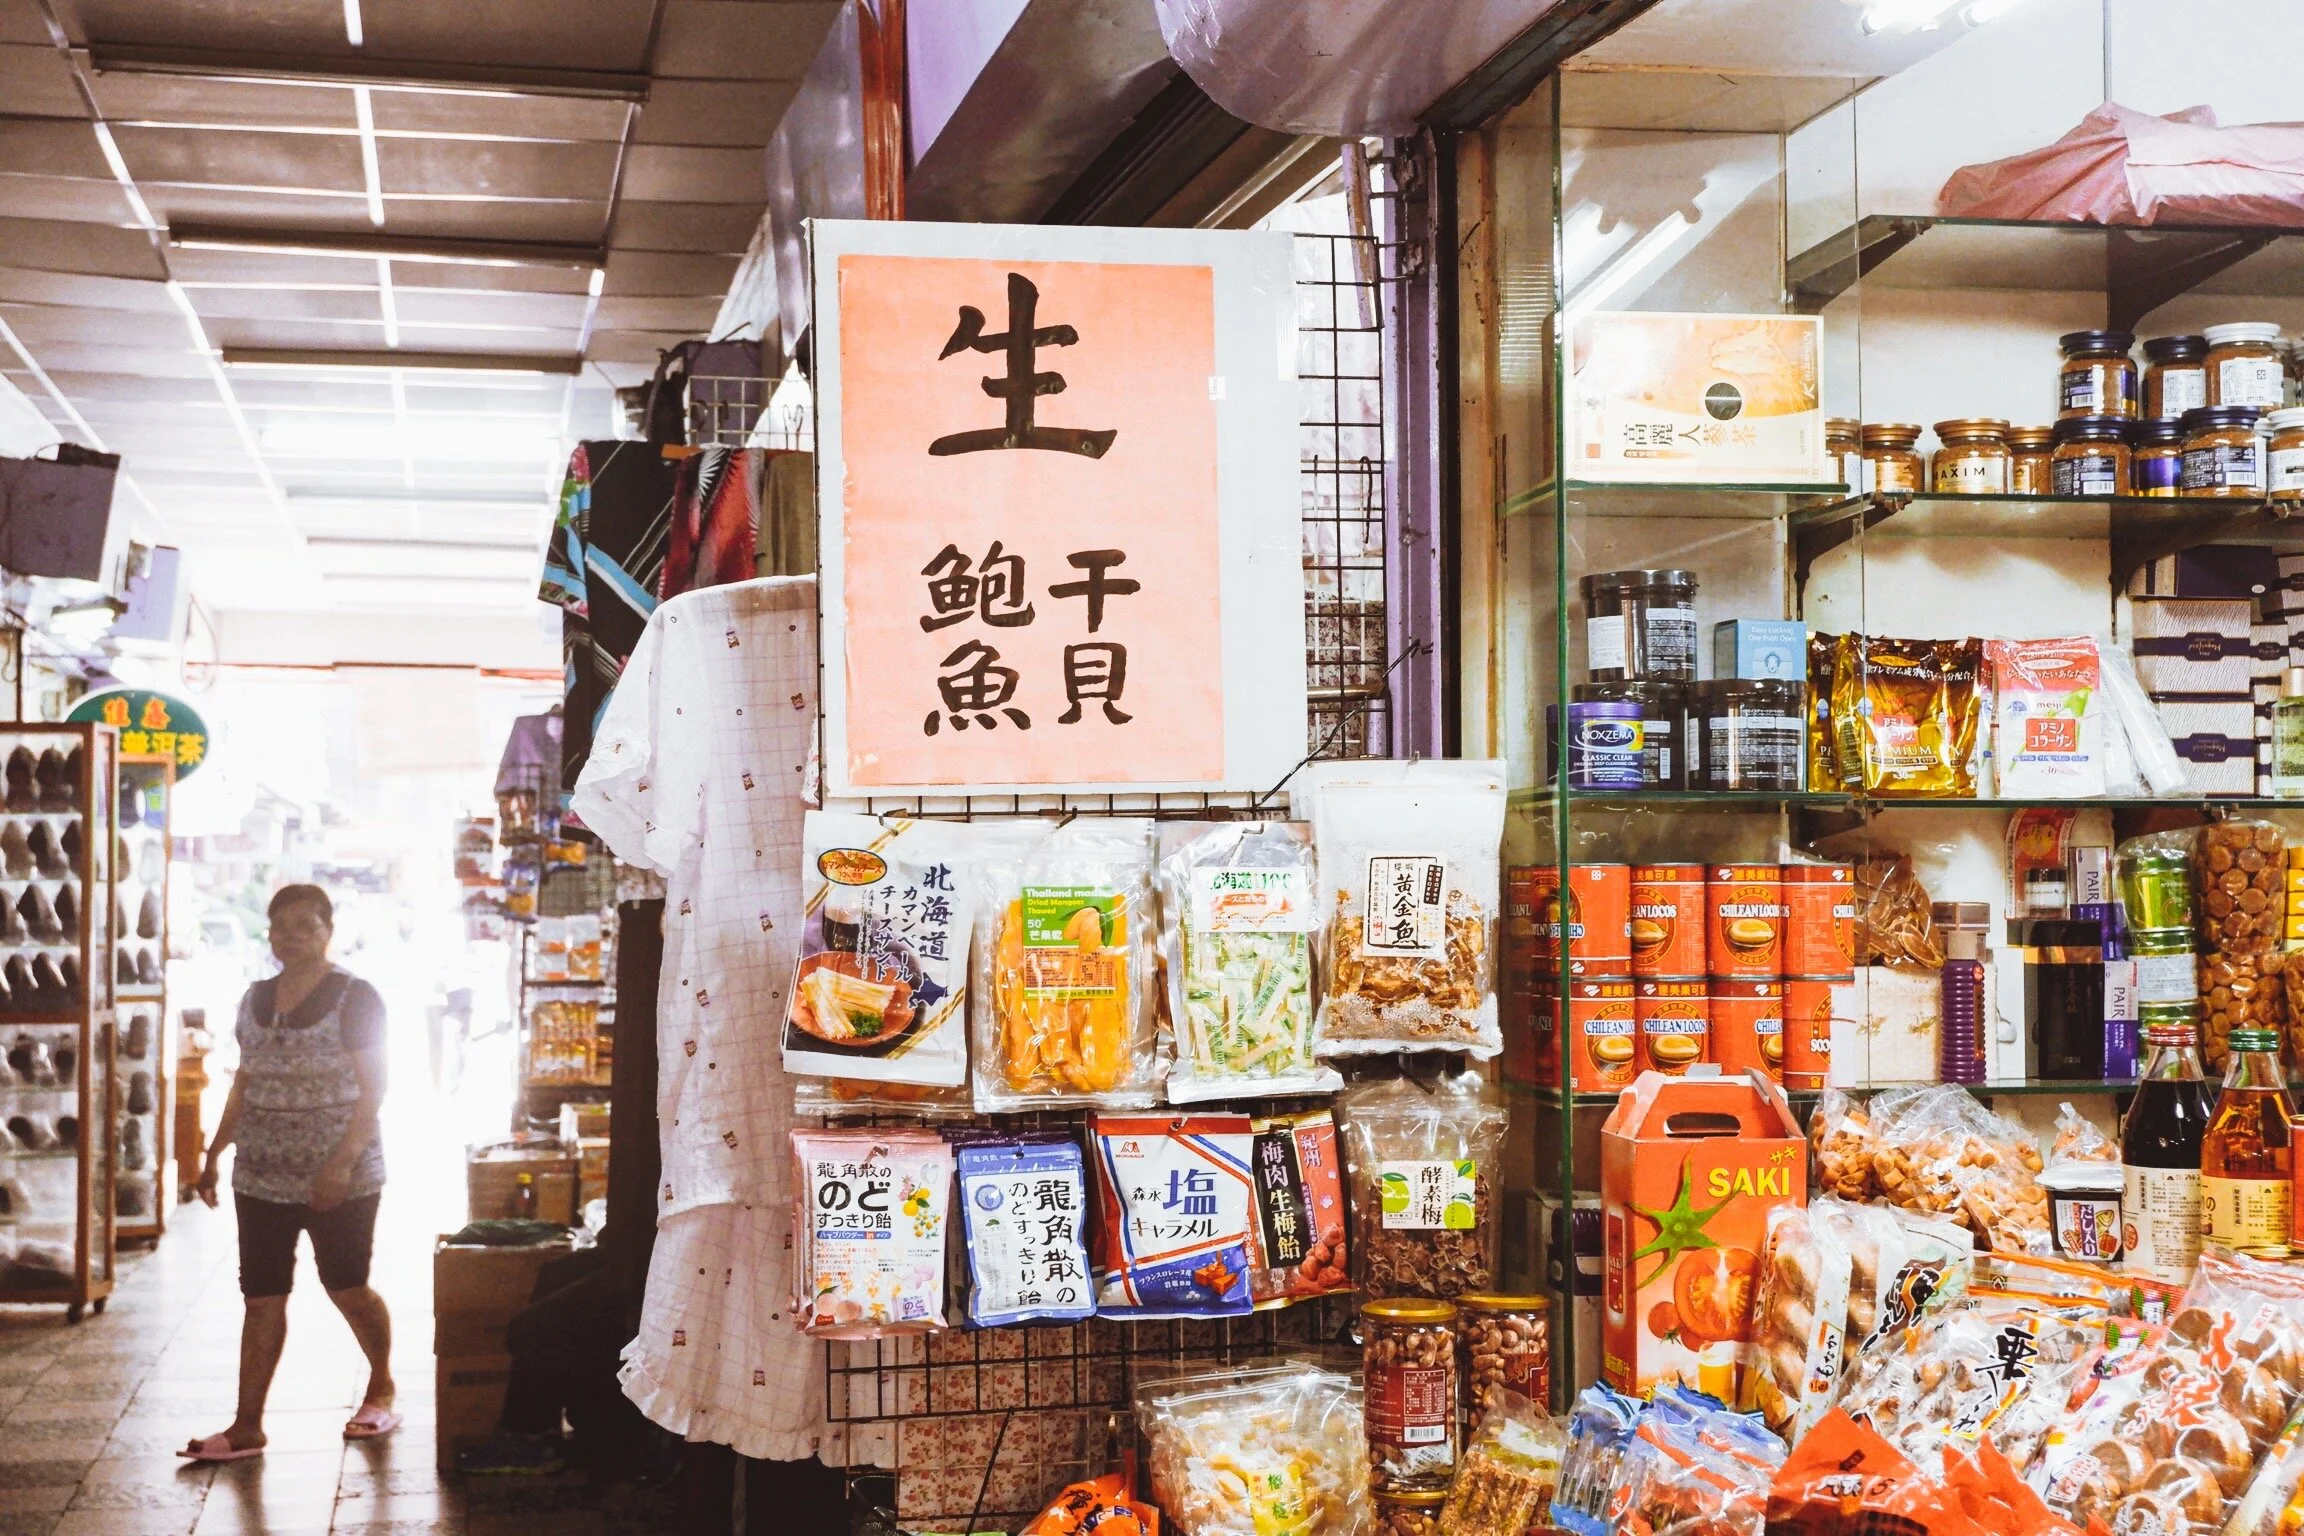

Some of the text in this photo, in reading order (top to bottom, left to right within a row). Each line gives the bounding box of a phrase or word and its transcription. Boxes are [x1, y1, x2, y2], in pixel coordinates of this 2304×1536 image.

[928, 272, 1118, 460] 生
[919, 540, 1036, 736] 鮑魚
[1047, 549, 1142, 725] 干貝
[1582, 730, 1632, 743] NOXZEMA
[2030, 735, 2074, 748] コラーゲン
[2039, 722, 2065, 734] アミノ
[1026, 888, 1072, 898] Thailand
[2086, 871, 2100, 903] PAIR
[919, 862, 955, 961] 北海道
[1388, 873, 1418, 948] 黄金魚
[1647, 904, 1677, 918] LOCOS
[1719, 904, 1758, 918] CHILEAN
[875, 885, 898, 982] チーズサンド
[895, 886, 918, 982] カマンベール
[2110, 987, 2126, 1019] PAIR
[1586, 1020, 1624, 1035] CHILEAN
[1644, 1019, 1684, 1034] CHILEAN
[1300, 1134, 1322, 1168] 紀州
[1769, 1144, 1798, 1166] サキ
[816, 1162, 892, 1179] 龍角散の
[1706, 1166, 1791, 1199] SAKI
[818, 1180, 892, 1212] のど
[1162, 1168, 1219, 1215] 塩
[1260, 1140, 1301, 1261] 梅肉生梅飴
[1421, 1166, 1443, 1226] 酵素梅
[816, 1213, 892, 1229] すっきり飴
[1130, 1217, 1220, 1239] キャラメル
[2080, 1205, 2097, 1256] だし入り
[1008, 1182, 1042, 1306] のどすっきり飴
[1033, 1179, 1084, 1304] 龍角散の
